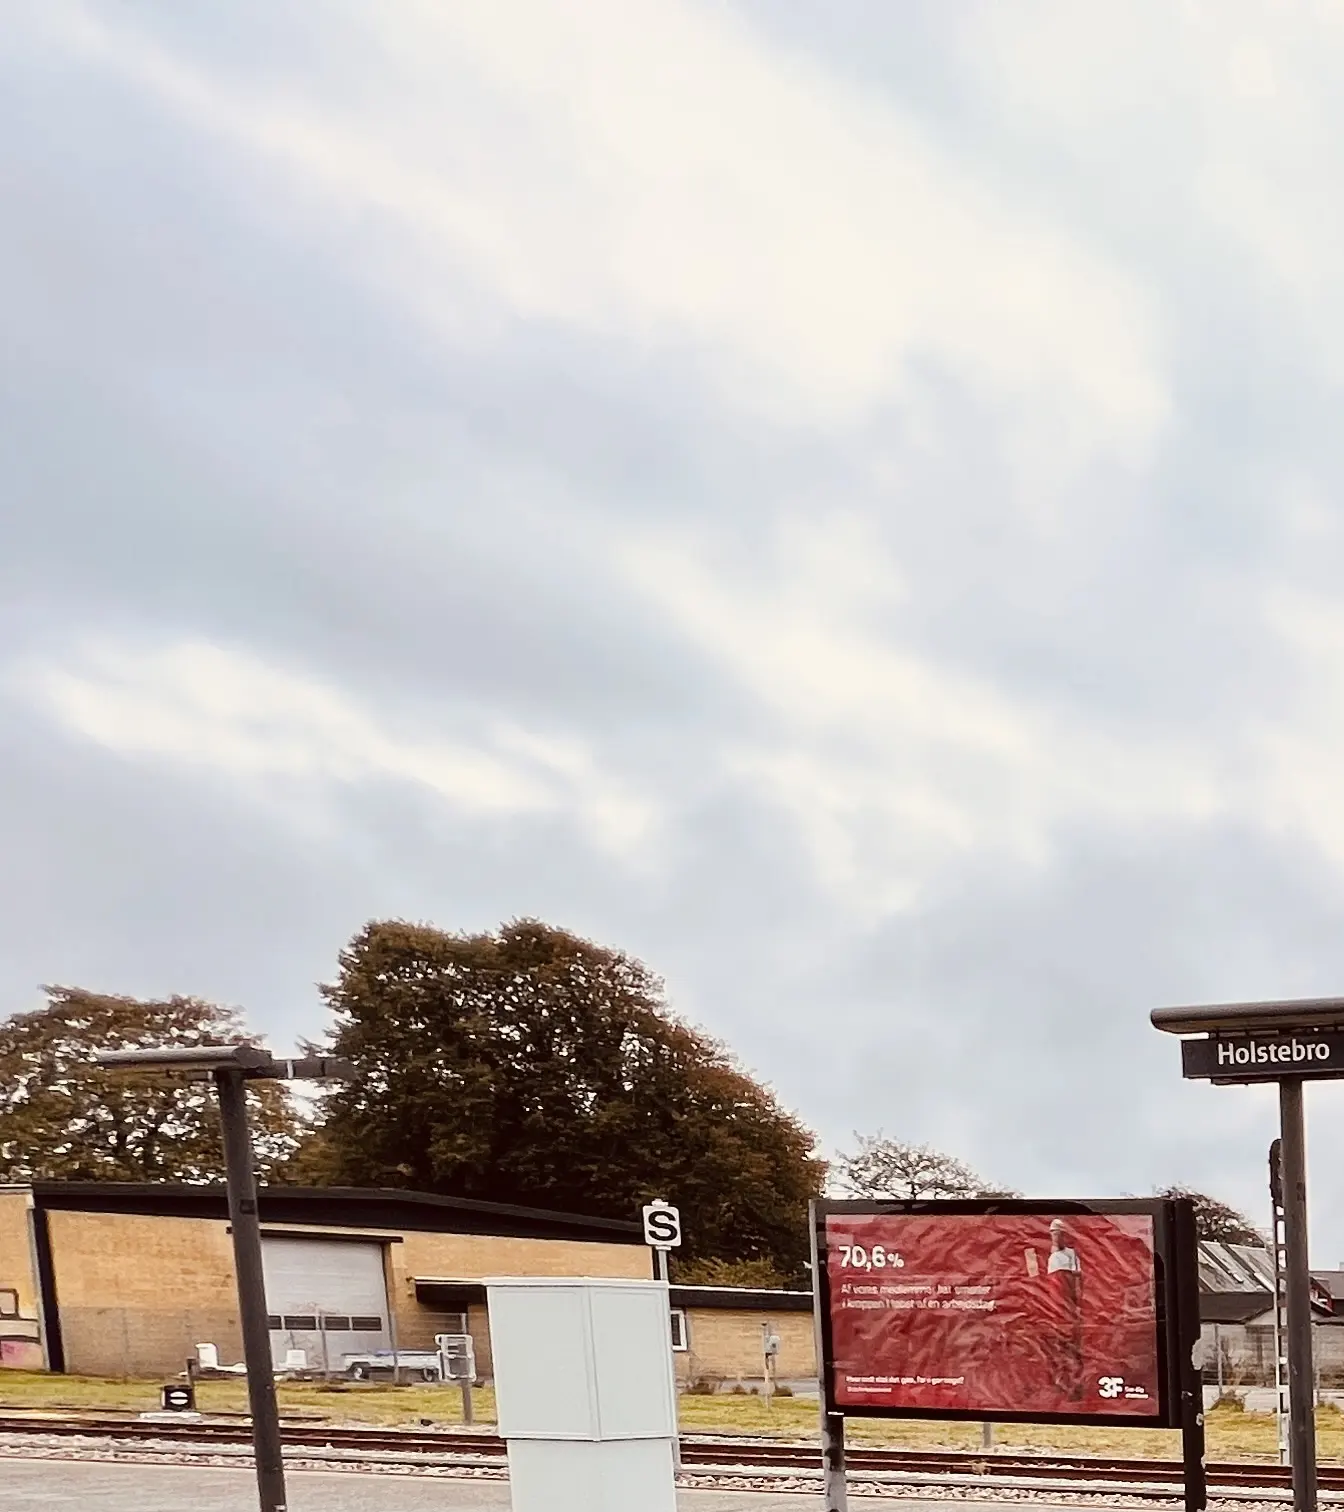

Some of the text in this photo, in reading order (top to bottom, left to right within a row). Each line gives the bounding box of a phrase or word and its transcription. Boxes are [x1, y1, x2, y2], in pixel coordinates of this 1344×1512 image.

[1218, 1038, 1330, 1065] Holstebro
[648, 1210, 678, 1241] S
[1098, 1376, 1124, 1398] 3F
